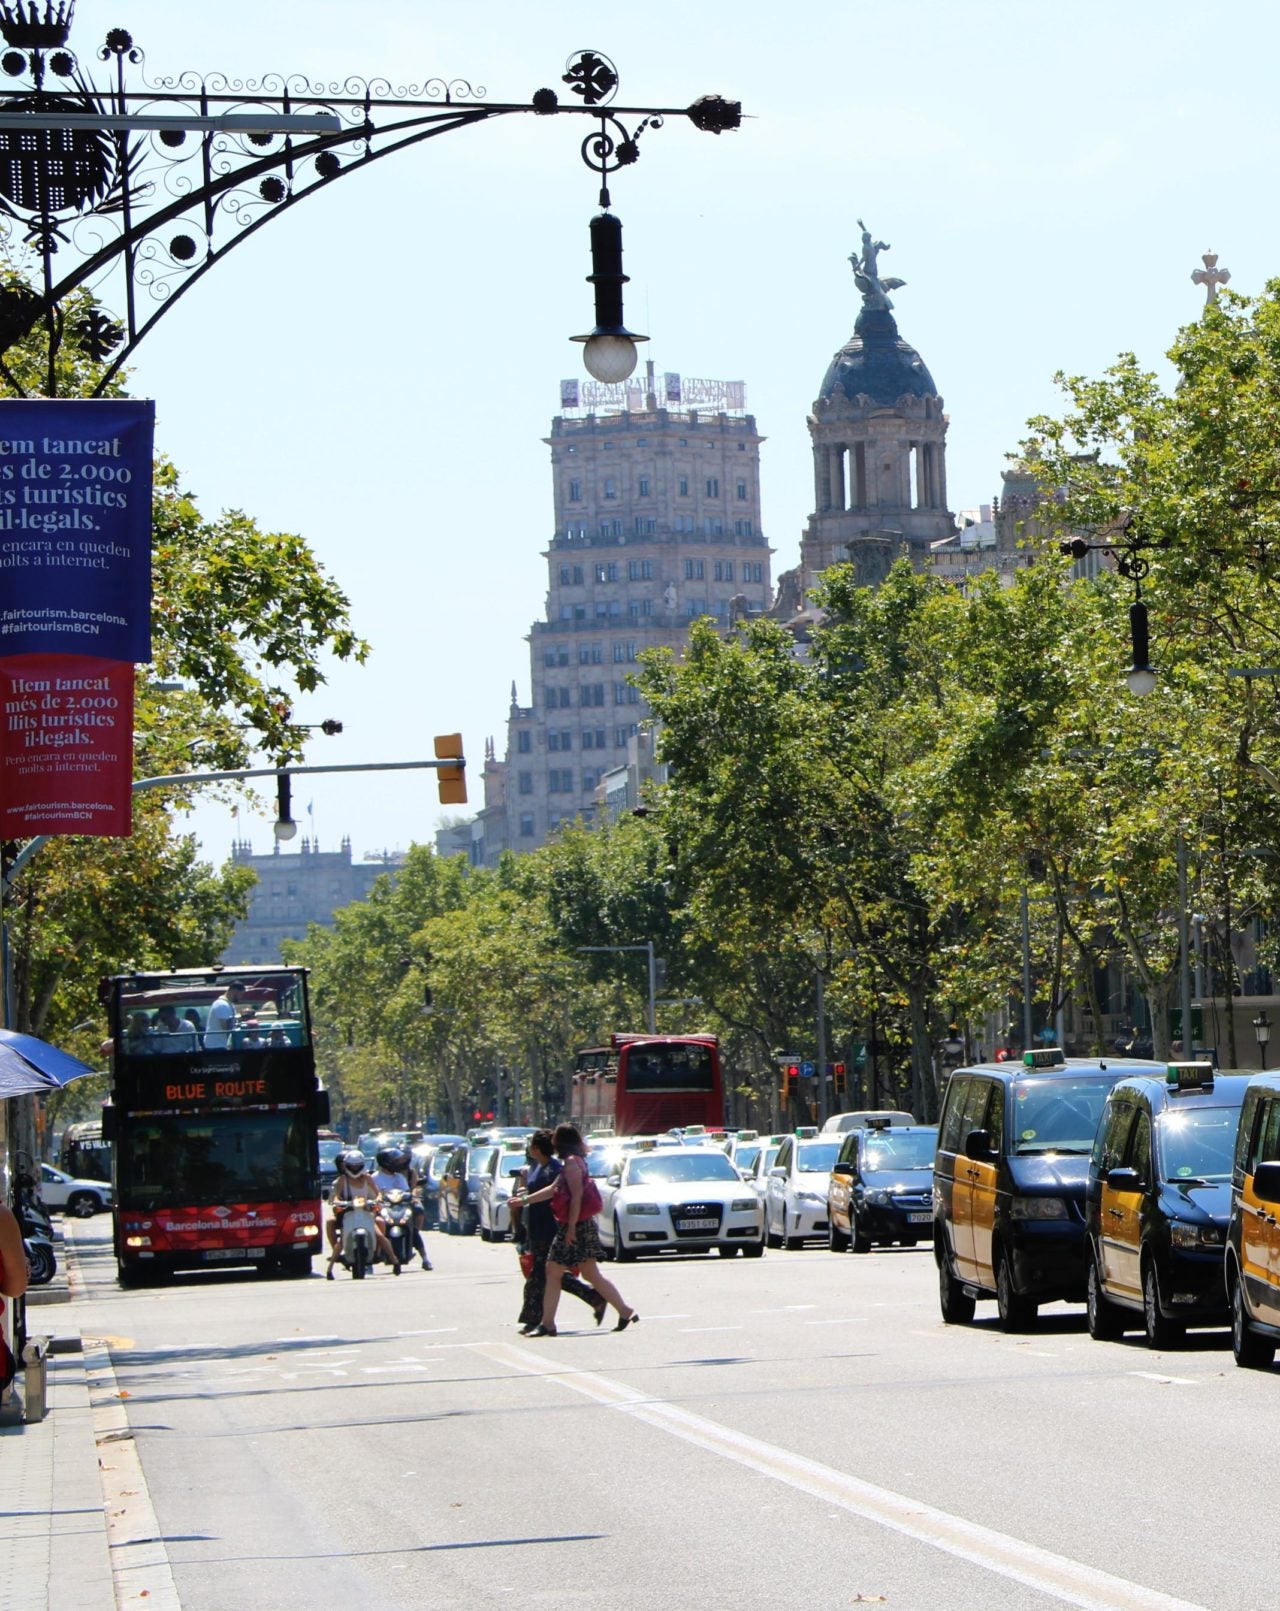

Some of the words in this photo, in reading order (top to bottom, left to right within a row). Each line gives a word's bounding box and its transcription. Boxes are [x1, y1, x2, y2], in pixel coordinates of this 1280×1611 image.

[43, 437, 121, 457] tancat
[0, 464, 14, 480] s
[21, 458, 51, 479] de
[59, 464, 131, 483] 2.000
[0, 488, 16, 505] s
[23, 481, 127, 508] turístics
[2, 541, 52, 553] encara
[56, 541, 75, 551] en
[80, 541, 130, 558] queden
[33, 556, 42, 566] a
[46, 552, 110, 569] internet.
[1, 621, 100, 634] #fairtourismBCN
[11, 679, 51, 694] Hem
[55, 677, 110, 691] tancat
[5, 695, 37, 714] més
[41, 693, 61, 710] de
[66, 696, 119, 709] 2.000
[8, 714, 38, 731] llits
[42, 710, 115, 727] turístics
[25, 728, 95, 748] il·legals.
[5, 754, 26, 766] Però
[27, 753, 61, 764] encara
[62, 752, 76, 761] en
[79, 750, 118, 763] queden
[18, 763, 45, 775] molts
[46, 764, 53, 772] a
[55, 761, 101, 773] internet.
[24, 811, 93, 821] #fairtourismBCN
[1034, 1052, 1051, 1063] TAXI
[1179, 1068, 1198, 1080] TAXI
[166, 1083, 206, 1100] BLUE
[215, 1080, 266, 1096] ROUTE
[166, 1219, 220, 1231] Barcelona
